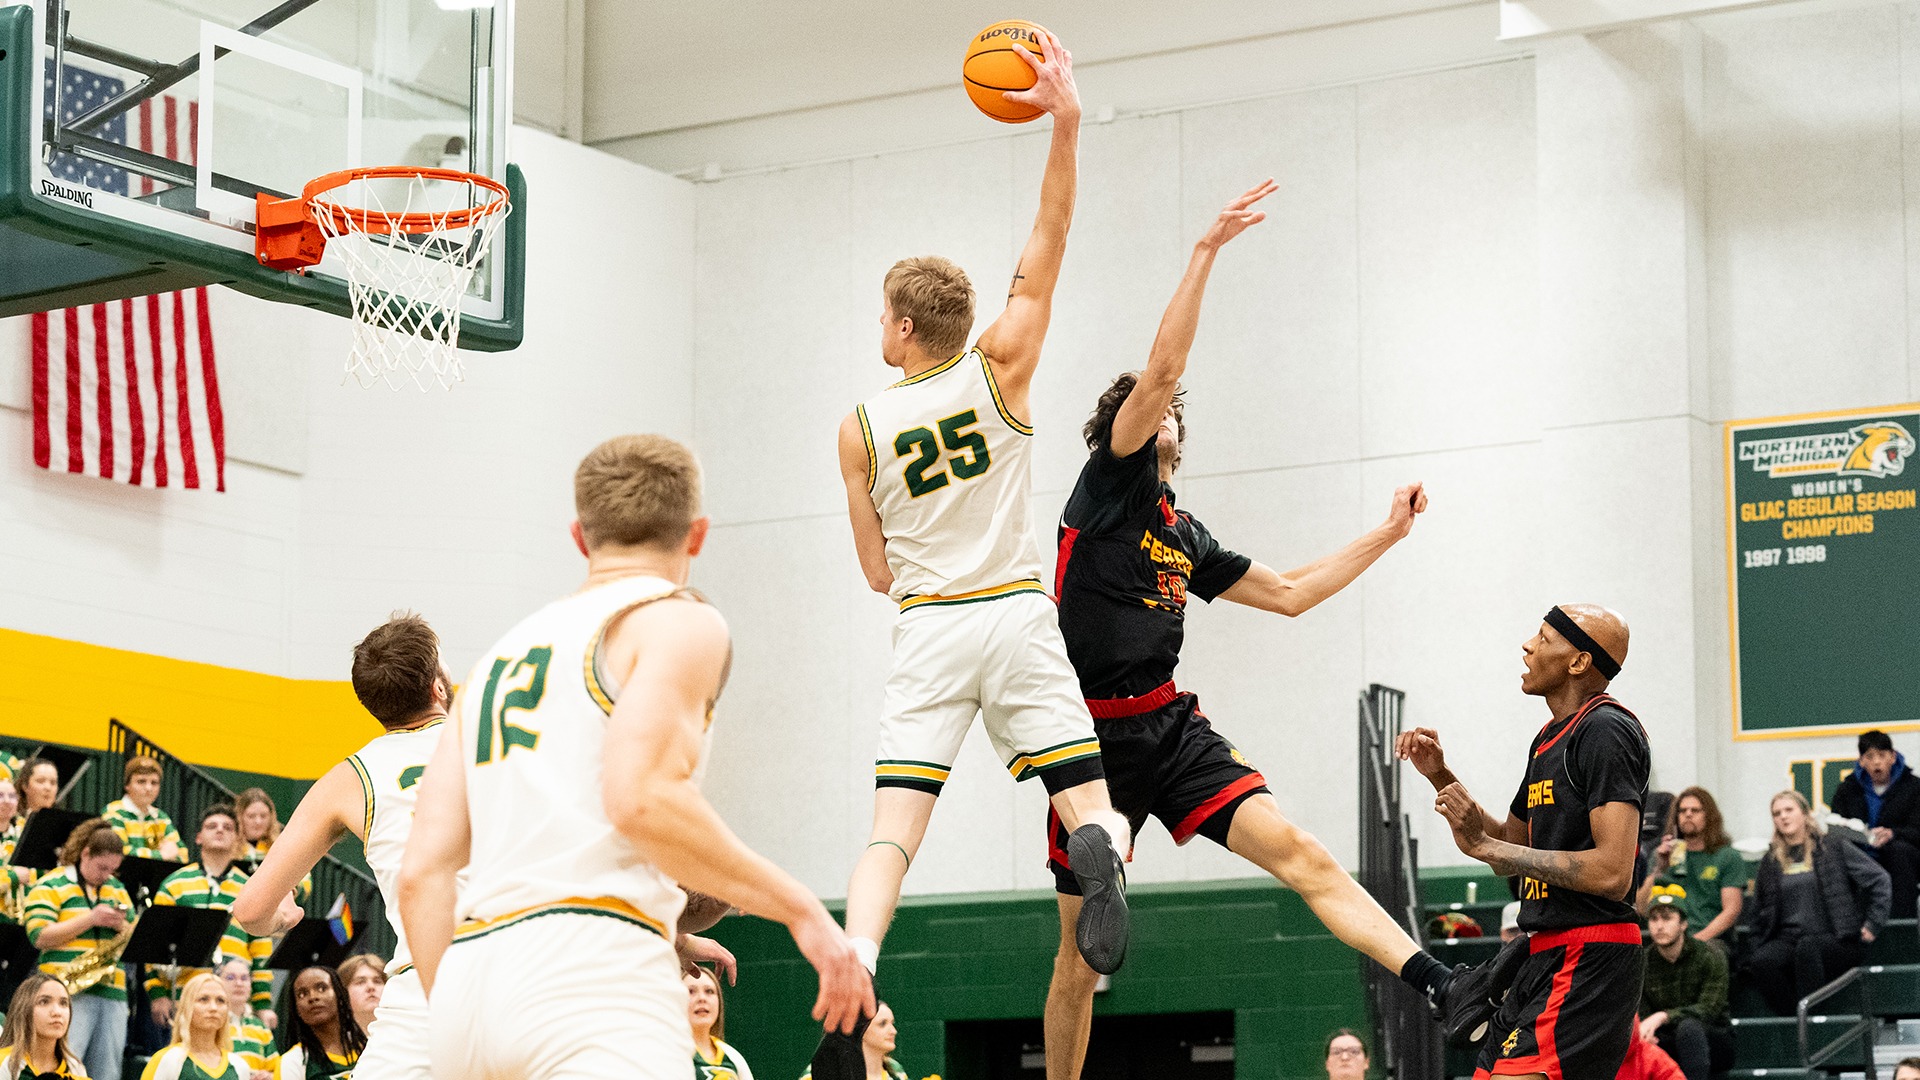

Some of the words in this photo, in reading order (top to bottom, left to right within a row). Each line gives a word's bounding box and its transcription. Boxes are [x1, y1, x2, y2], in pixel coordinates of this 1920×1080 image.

[41, 179, 93, 209] SPALDING
[892, 407, 993, 500] 25
[1742, 435, 1848, 457] NORTHERN
[1757, 449, 1849, 467] MICHIGAN
[1791, 478, 1863, 498] WOMEN'S
[1741, 500, 1785, 522] GLIAC
[1787, 495, 1854, 518] REGULAR
[1857, 489, 1916, 512] SEASON
[1782, 514, 1874, 540] CHAMPIONS
[1744, 548, 1781, 568] 1997
[1787, 545, 1826, 564] 1998
[475, 644, 553, 767] 12
